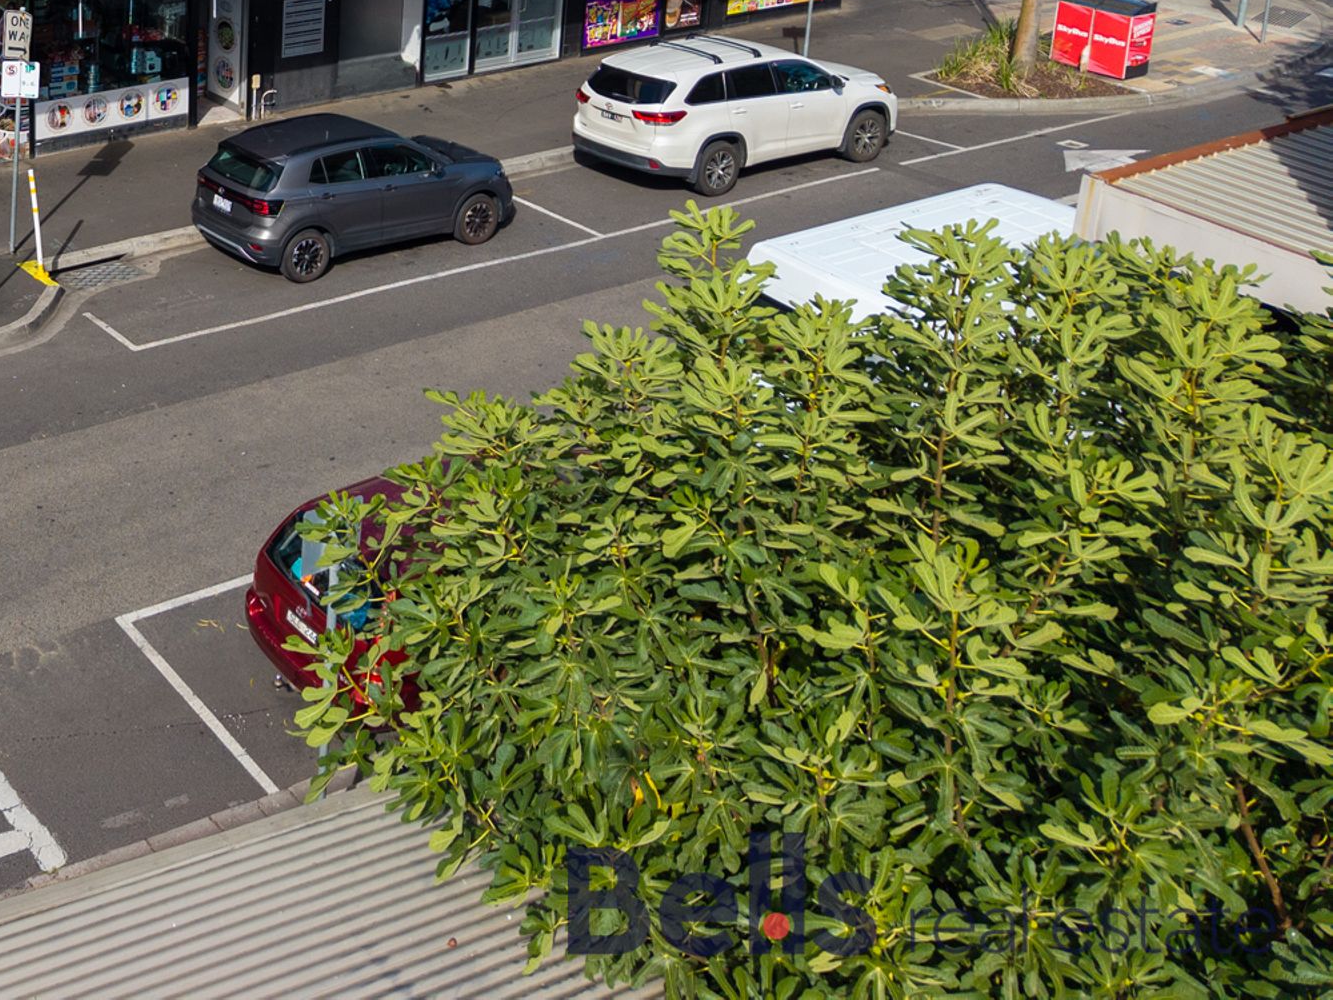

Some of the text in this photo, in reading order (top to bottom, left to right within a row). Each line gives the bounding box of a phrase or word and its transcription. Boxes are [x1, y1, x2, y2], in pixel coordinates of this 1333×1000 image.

[11, 15, 29, 29] ONE
[1057, 23, 1088, 37] SkyBus
[1093, 33, 1126, 47] SkyBus
